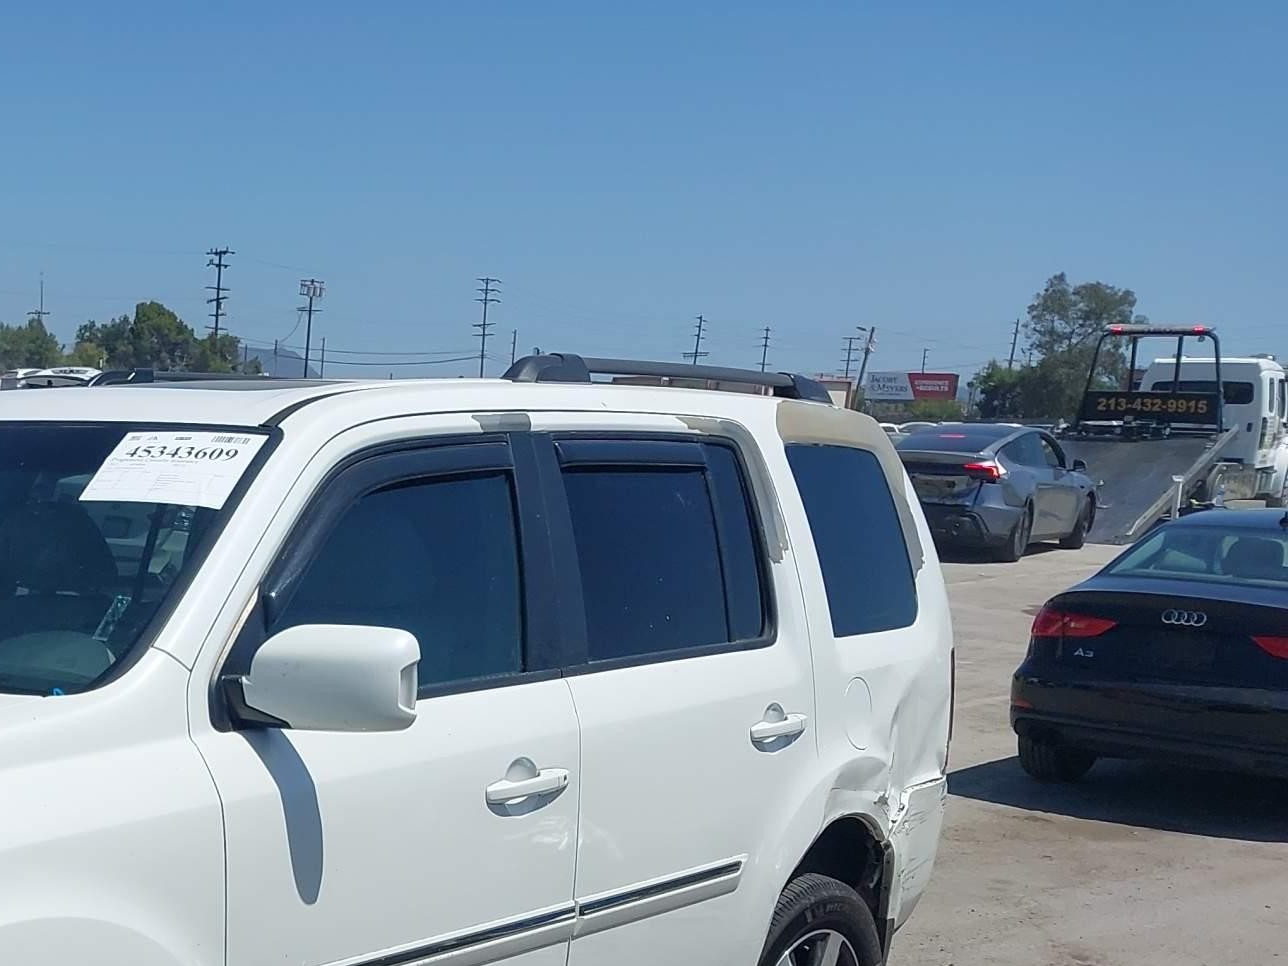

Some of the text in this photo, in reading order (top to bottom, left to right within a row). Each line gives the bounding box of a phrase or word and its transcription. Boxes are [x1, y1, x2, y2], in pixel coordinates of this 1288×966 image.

[1096, 397, 1208, 413] 213-432-9915
[125, 445, 240, 462] 45343609
[1073, 647, 1094, 658] A3
